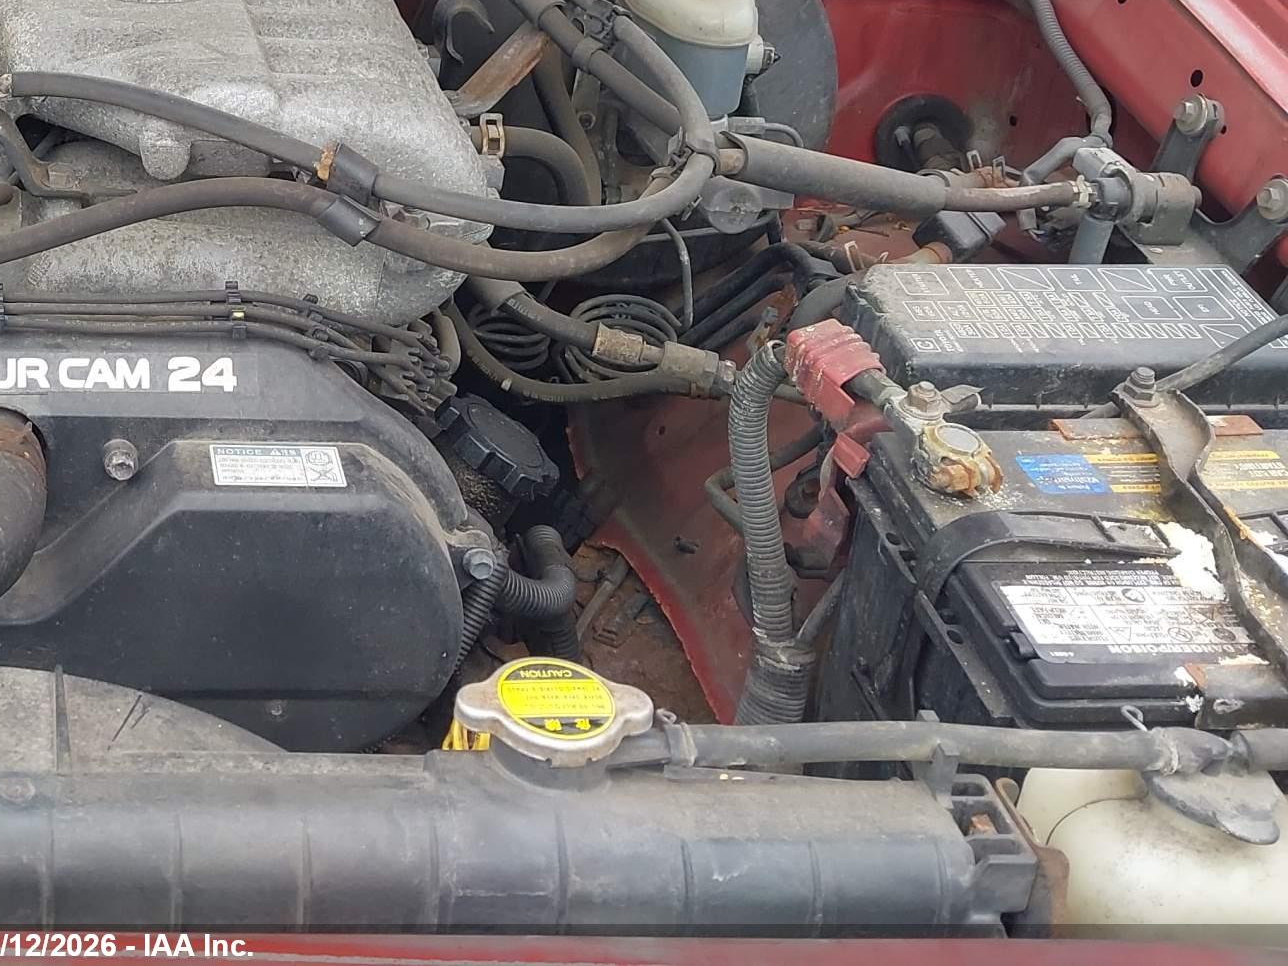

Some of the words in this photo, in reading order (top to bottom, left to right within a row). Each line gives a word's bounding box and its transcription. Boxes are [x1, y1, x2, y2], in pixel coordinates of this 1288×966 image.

[58, 356, 149, 390] CAM
[167, 356, 237, 392] 24
[216, 448, 262, 456] NOTICE
[519, 669, 573, 678] CAUTION
